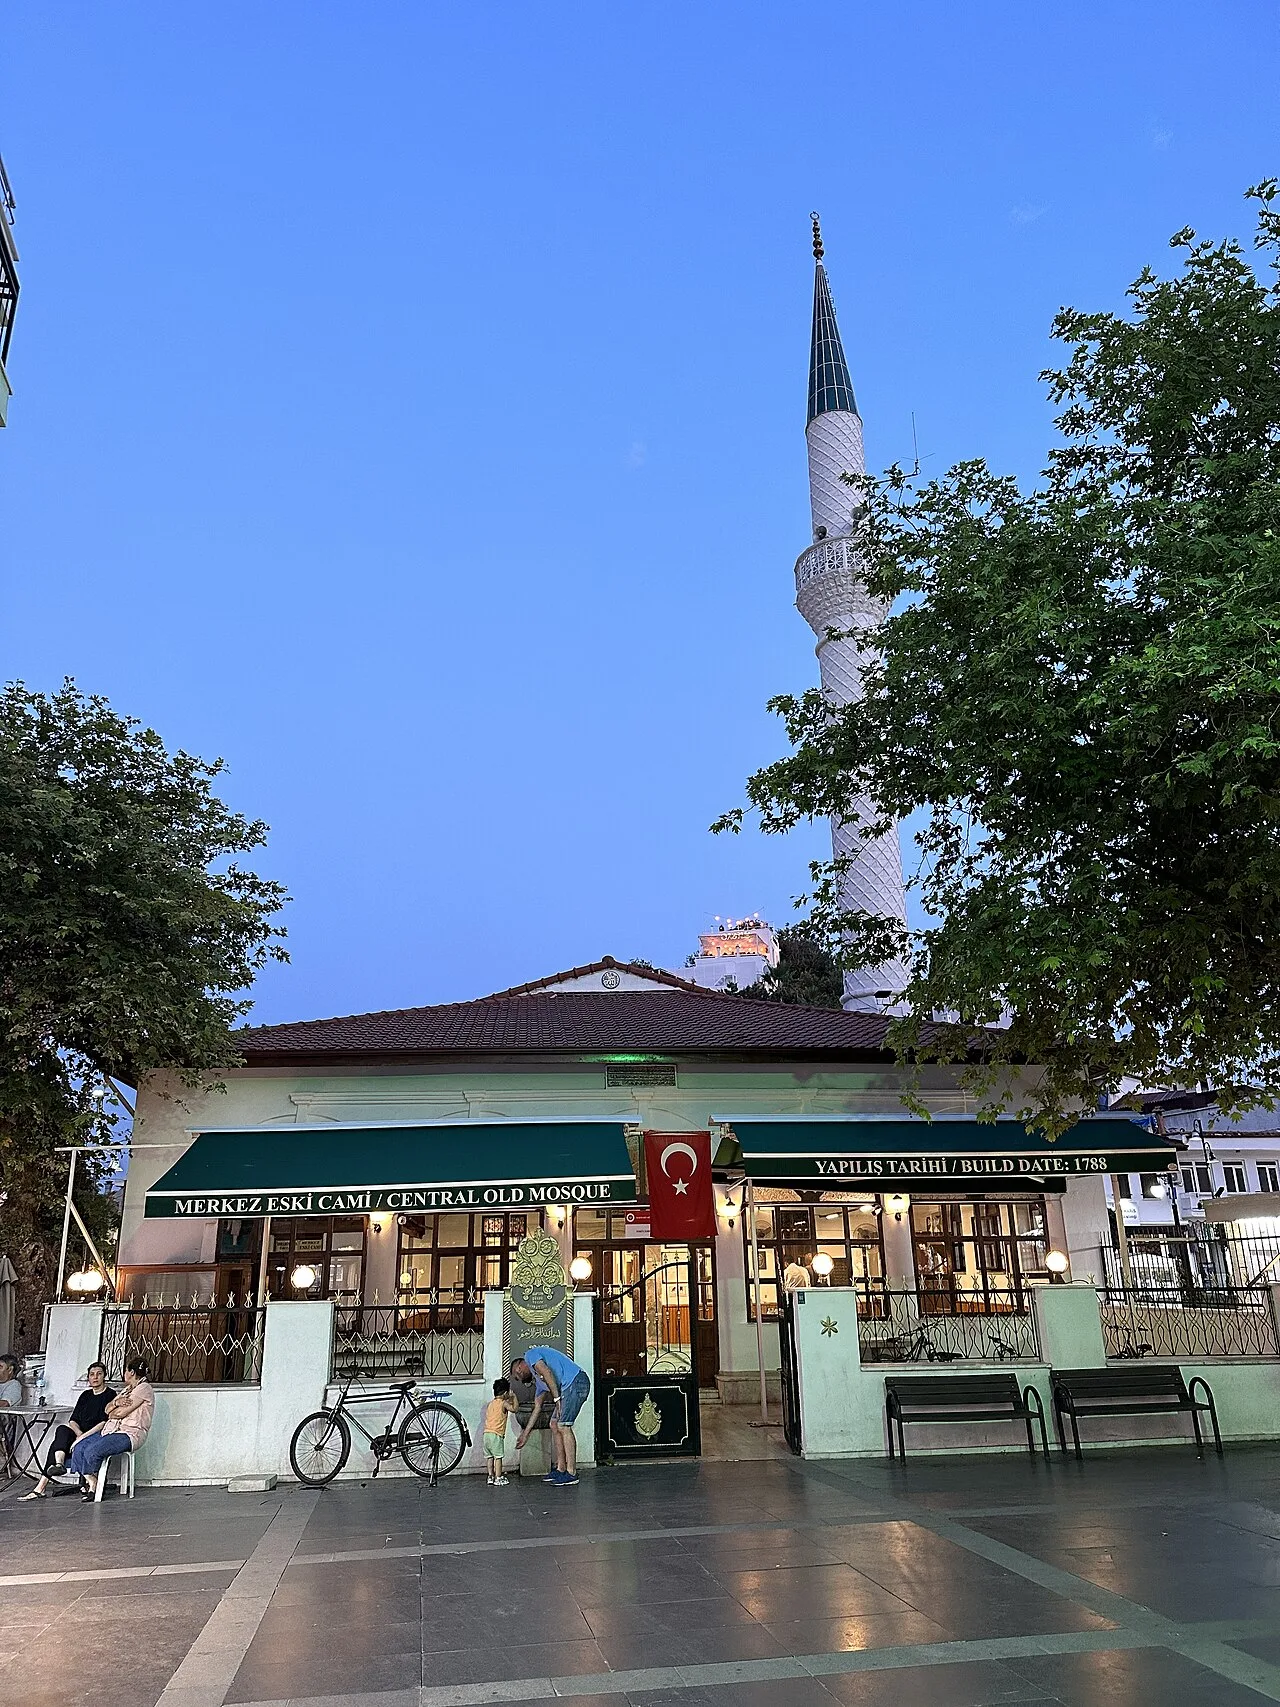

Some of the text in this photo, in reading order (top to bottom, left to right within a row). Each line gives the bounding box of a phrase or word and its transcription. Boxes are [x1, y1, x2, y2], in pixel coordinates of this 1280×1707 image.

[815, 1160, 883, 1176] YAPILIŞ
[886, 1157, 948, 1173] TARİHİ
[961, 1159, 1015, 1173] BUILD
[1018, 1158, 1070, 1172] DATE:
[1074, 1157, 1108, 1171] 1788
[174, 1198, 262, 1214] MERKEZ
[265, 1192, 314, 1212] ESKİ
[318, 1190, 372, 1210] CAMİ
[386, 1190, 480, 1208] CENTRAL
[483, 1187, 524, 1204] OLD
[528, 1183, 611, 1202] MOSQUE
